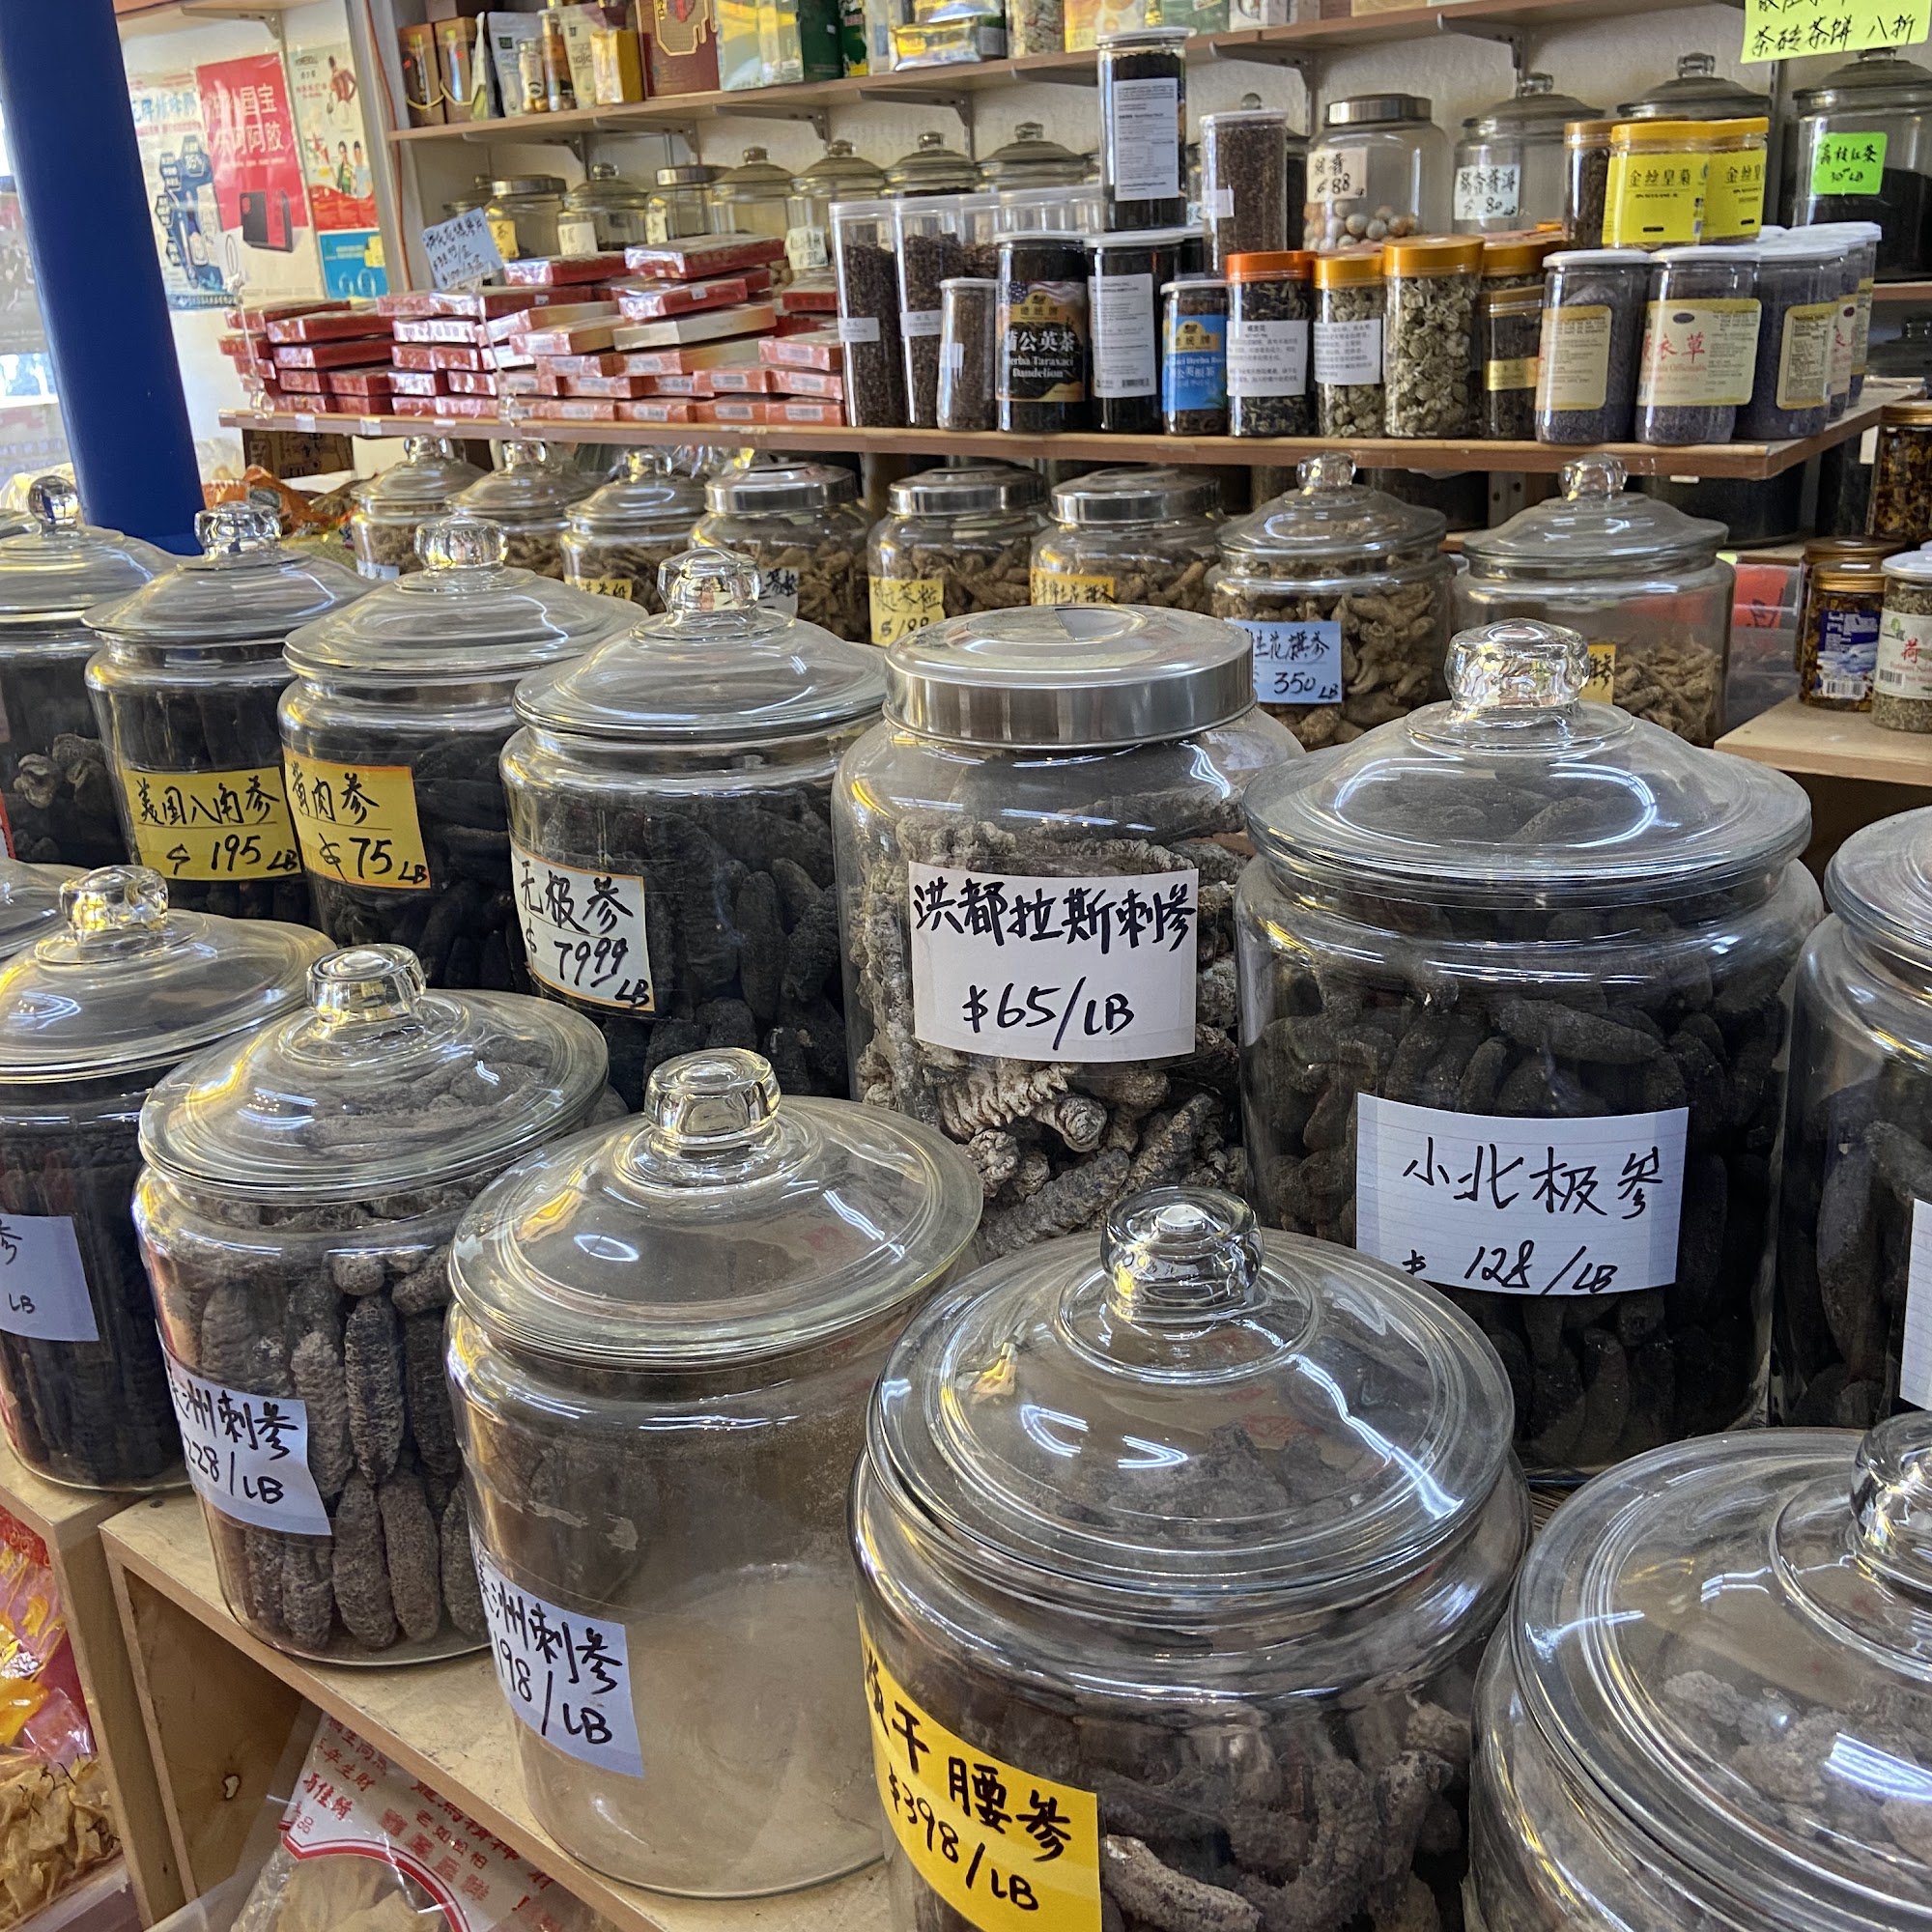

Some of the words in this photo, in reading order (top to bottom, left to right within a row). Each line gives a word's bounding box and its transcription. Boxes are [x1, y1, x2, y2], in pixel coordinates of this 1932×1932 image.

[1866, 14, 1916, 45] 八折
[1246, 628, 1330, 661] 生花旗参
[1274, 671, 1316, 695] 350
[1319, 683, 1339, 699] LB
[211, 834, 262, 871] 195
[267, 849, 298, 871] LB
[349, 838, 393, 879] 75
[398, 861, 428, 885] LB
[614, 979, 650, 1008] LB
[961, 976, 1135, 1051] $65/LB
[1403, 1136, 1663, 1220] 小北极参
[8, 1293, 36, 1315] LB
[889, 1762, 1038, 1911] $398/LB
